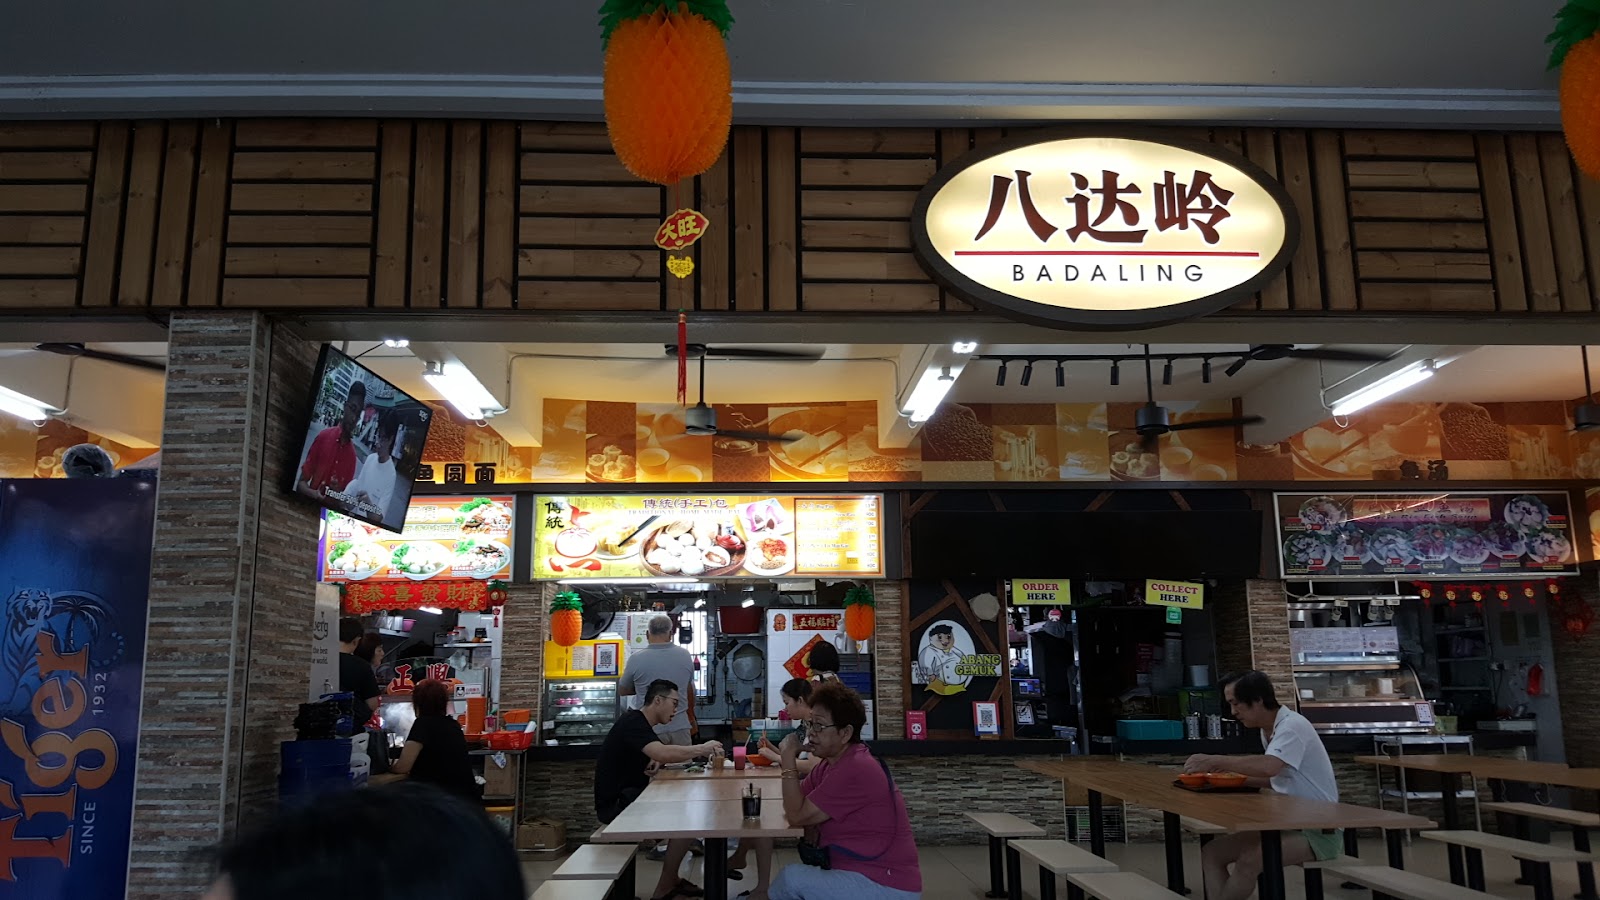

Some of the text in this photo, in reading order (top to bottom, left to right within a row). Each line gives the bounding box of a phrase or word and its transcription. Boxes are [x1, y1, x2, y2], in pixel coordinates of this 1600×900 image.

[974, 169, 1235, 245] 八达岭
[659, 215, 701, 244] 大旺
[1012, 264, 1204, 282] BADALING
[416, 462, 497, 485] 鱼圆面
[324, 485, 347, 502] Transfer
[359, 500, 377, 512] deposit
[642, 498, 728, 509] 傳統(手工)包
[544, 501, 565, 529] 傳統
[363, 584, 469, 603] 恭喜發財
[1022, 583, 1059, 591] ORDER
[1151, 583, 1199, 594] COLLECT
[1027, 593, 1056, 601] HERE
[1160, 593, 1189, 603] HERE
[799, 616, 836, 628] 五福臨門
[959, 653, 1001, 665] ABANG
[954, 665, 996, 676] GEMUK
[0, 629, 119, 883] Tiger
[81, 672, 107, 854] SINCE 1932
